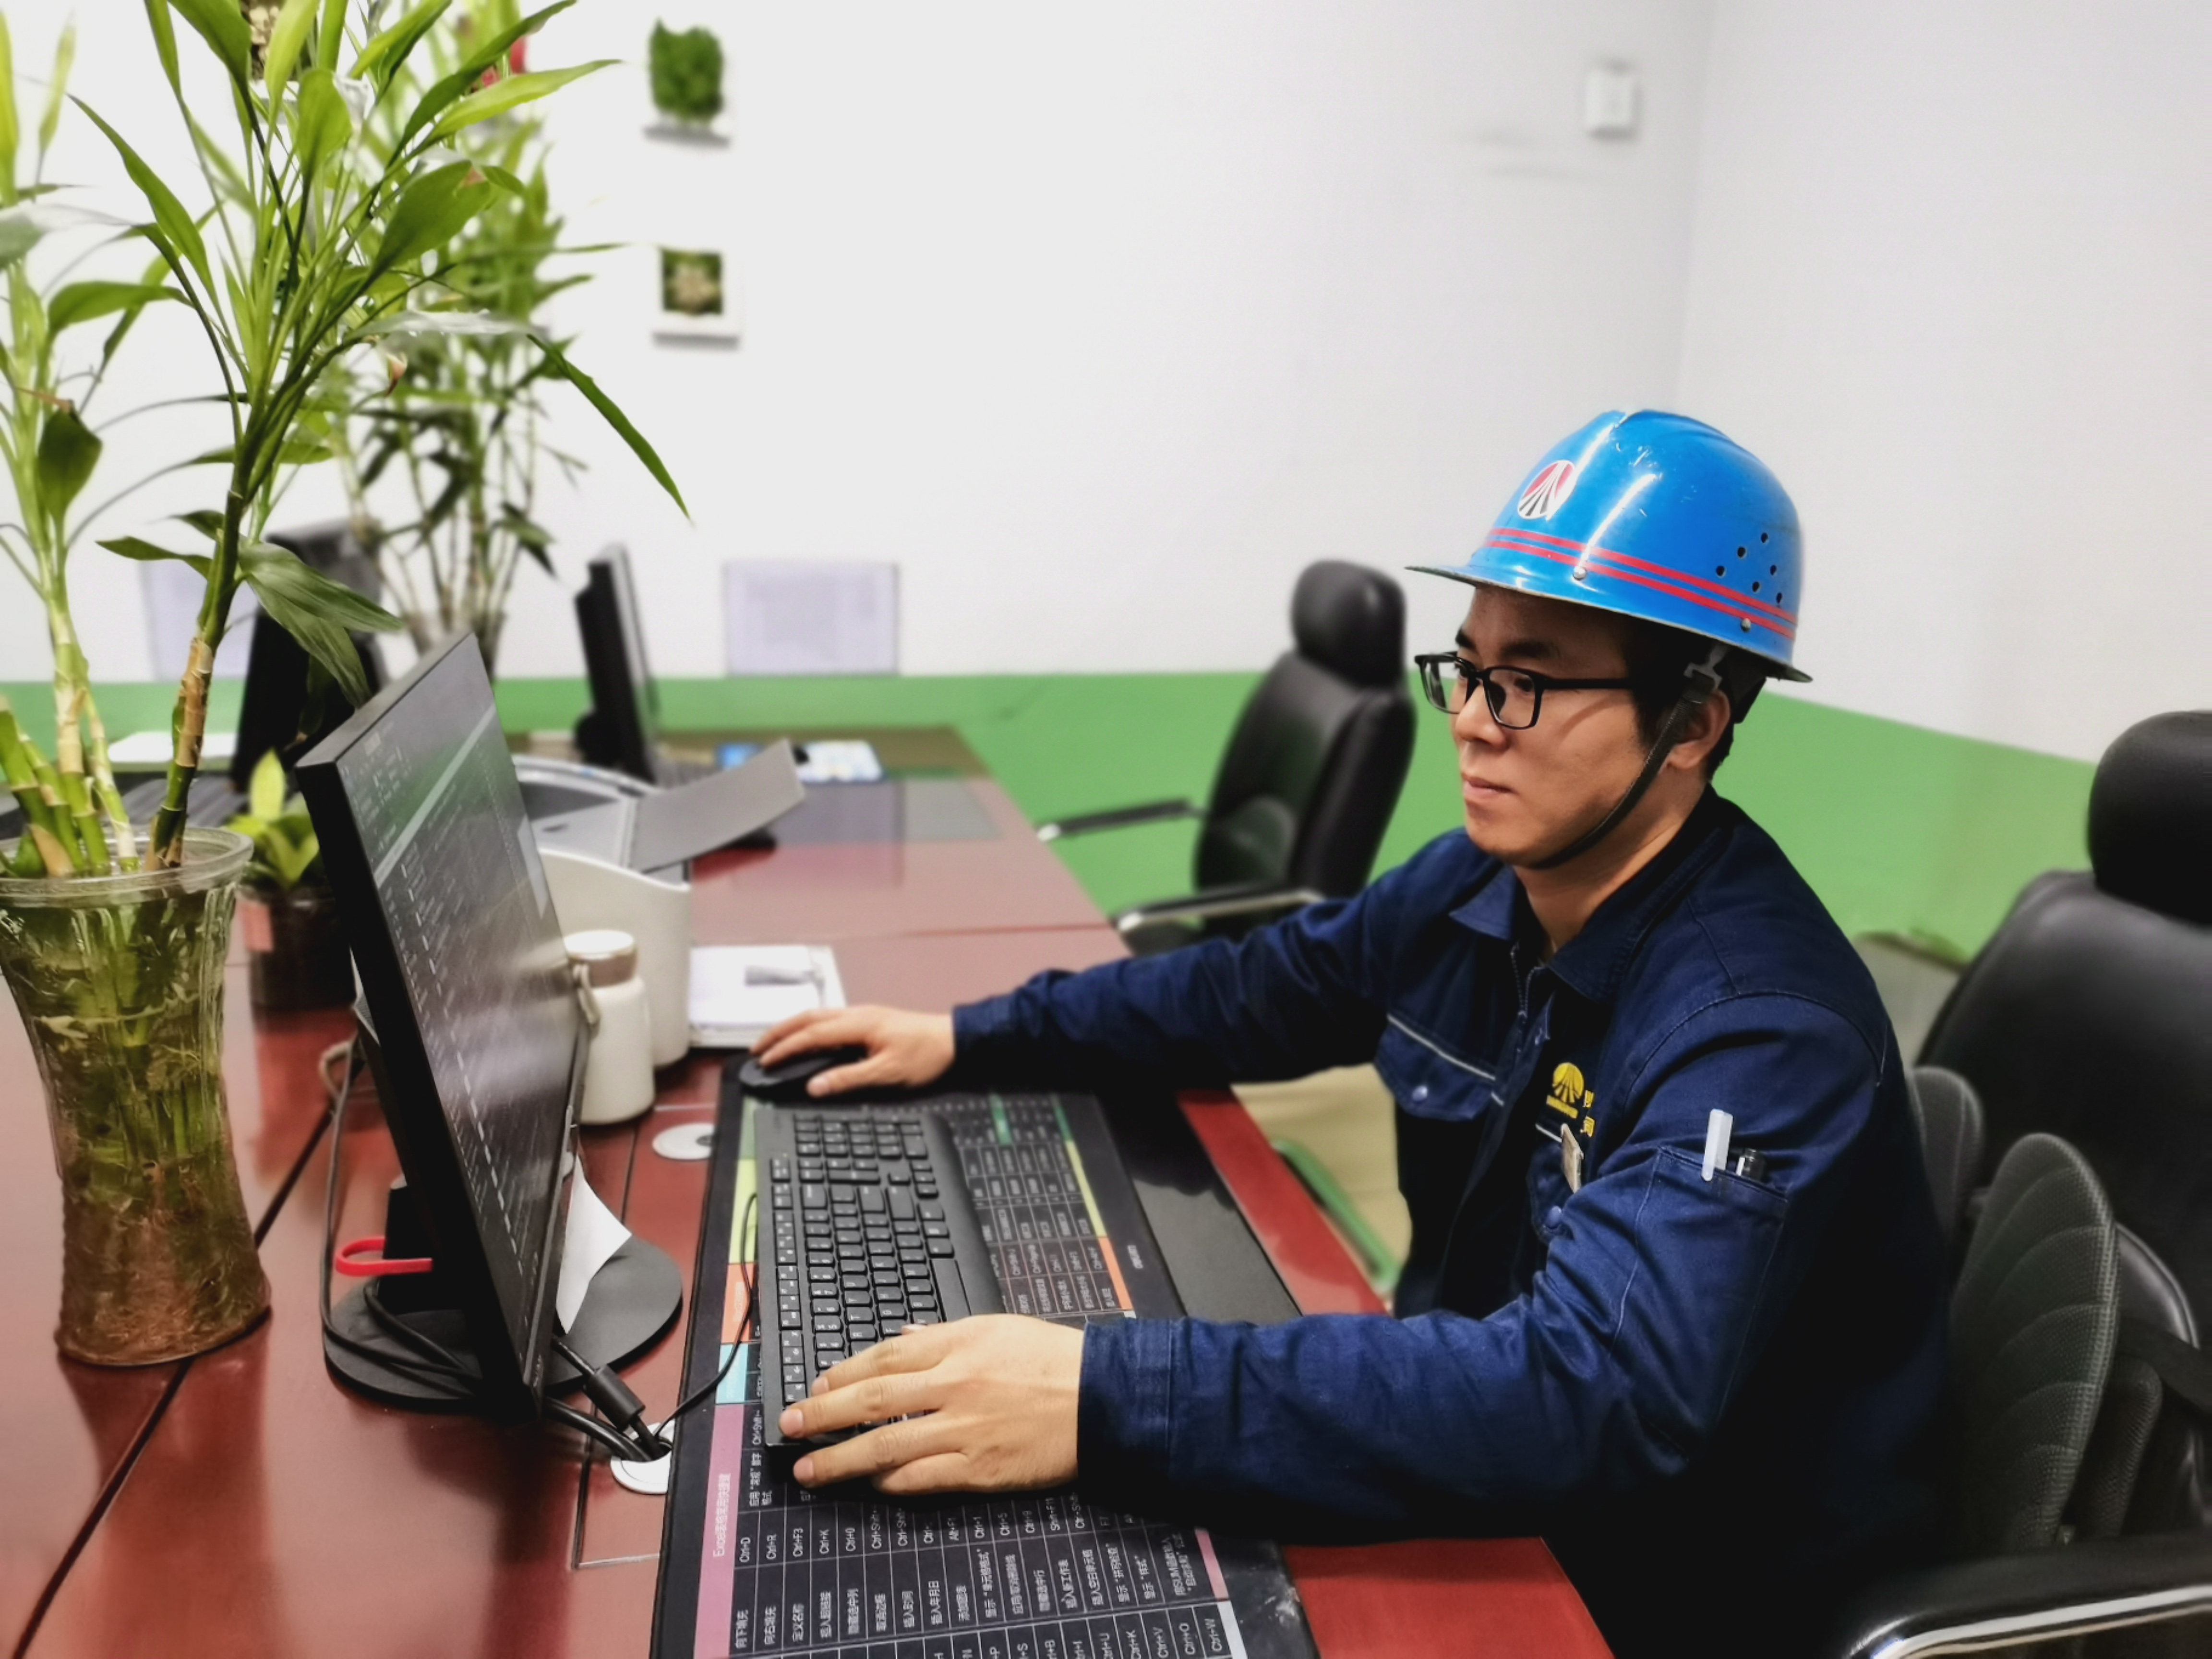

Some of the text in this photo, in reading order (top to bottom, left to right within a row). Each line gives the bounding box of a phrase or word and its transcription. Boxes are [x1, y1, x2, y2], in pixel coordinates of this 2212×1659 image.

[739, 1537, 751, 1563] Ctrl+D
[766, 1534, 777, 1560] Ctrl+R
[792, 1527, 804, 1557] Ctrl+F3
[819, 1529, 830, 1554] Ctrl+K
[1153, 1627, 1169, 1658] Ctrl+V
[1204, 1618, 1223, 1652] Ctrl+W
